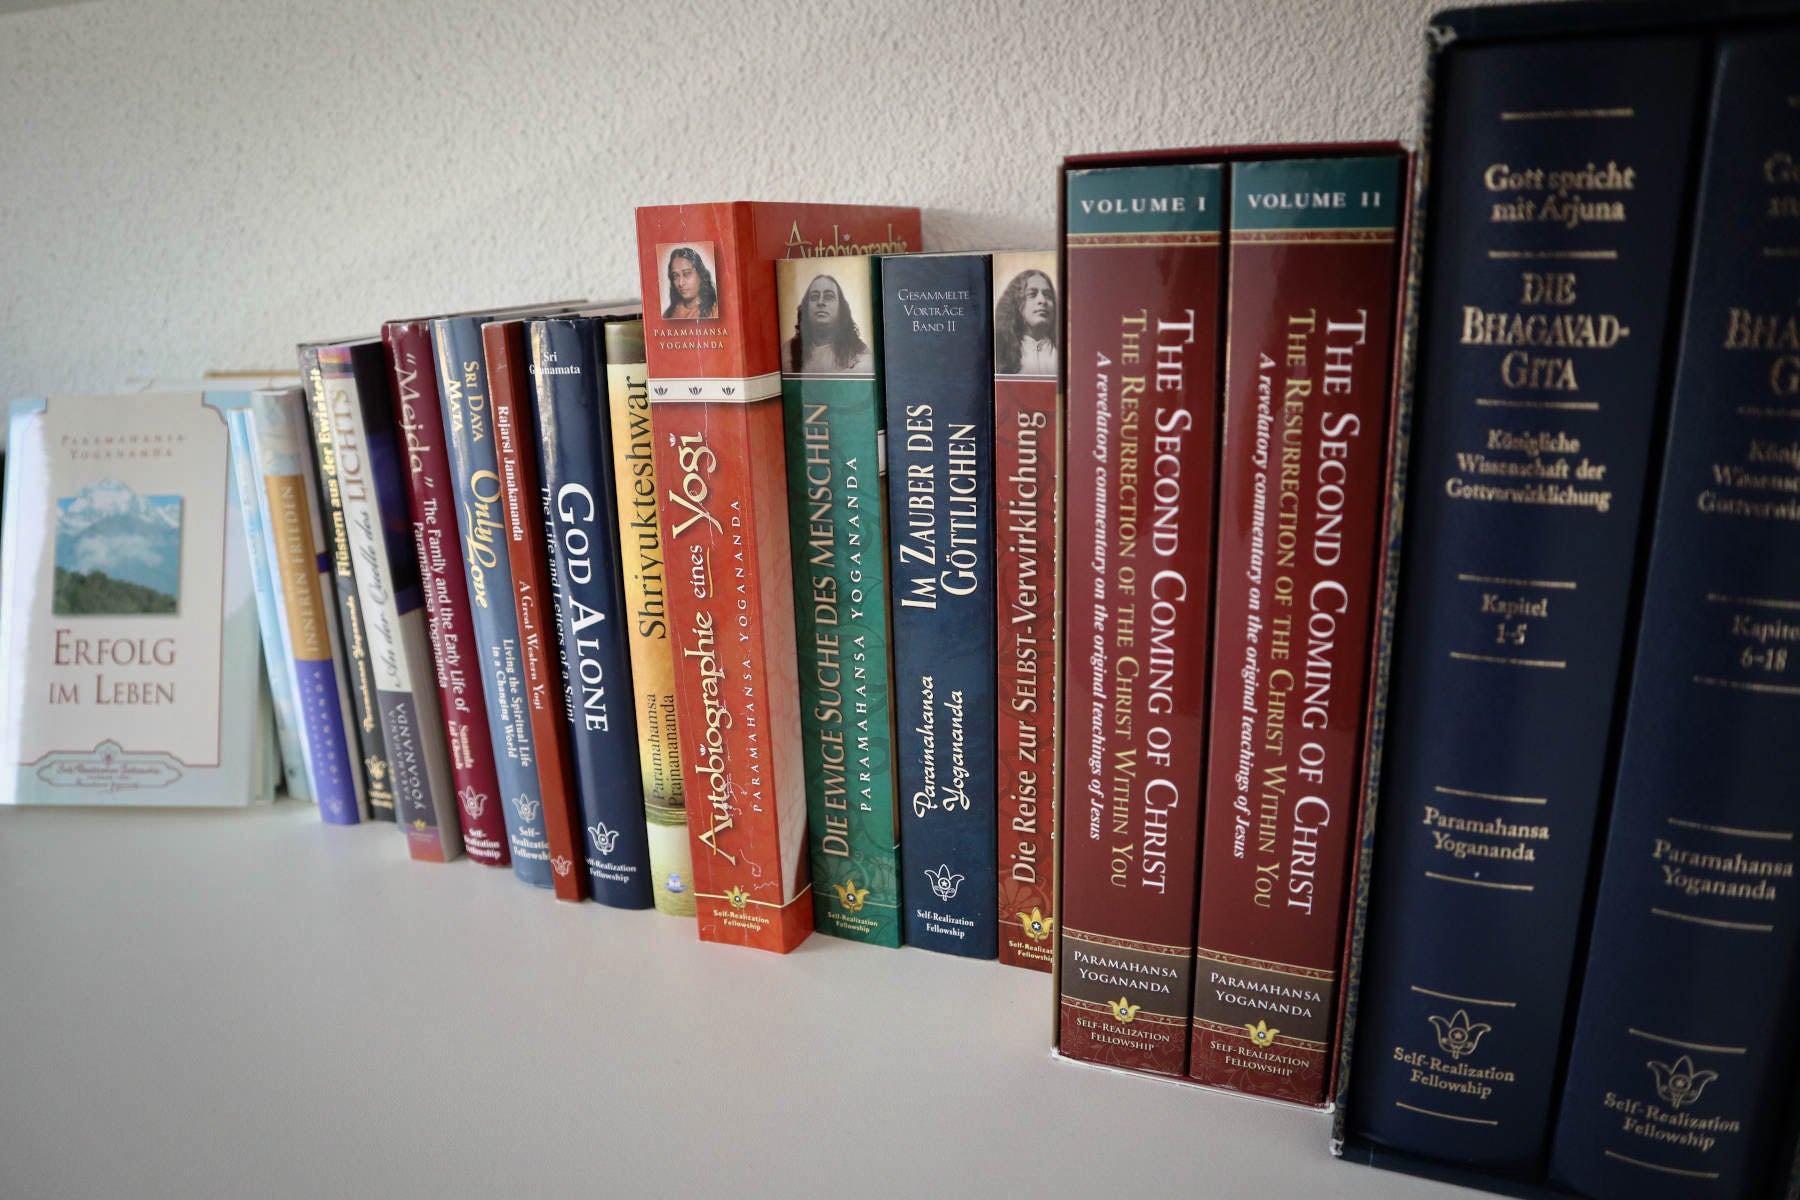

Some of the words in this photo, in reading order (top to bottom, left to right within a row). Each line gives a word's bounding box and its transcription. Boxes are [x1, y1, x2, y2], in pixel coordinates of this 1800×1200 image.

[1247, 192, 1347, 209] VOLUME
[1360, 191, 1381, 207] II
[1484, 163, 1544, 192] Gott
[1549, 161, 1636, 197] spricht
[1081, 197, 1186, 214] VOLUME
[1490, 197, 1535, 222] mit
[1539, 194, 1626, 229] Arjuna
[898, 288, 970, 301] GESAMMELTE
[904, 304, 965, 317] VORTRÄGE
[1521, 272, 1577, 306] DIE
[653, 326, 728, 337] PARAMAHANSA
[659, 340, 725, 350] YOGANANDA
[912, 321, 944, 332] BAND
[1121, 308, 1147, 366] THE
[1286, 308, 1316, 368] THE
[1460, 306, 1630, 348] BHAGAVAD-
[543, 351, 558, 362] Sri
[1096, 351, 1112, 367] A
[1155, 309, 1195, 393] THE
[1259, 351, 1277, 369] A
[1323, 308, 1368, 396] THE
[1501, 350, 1579, 391] GITA
[447, 378, 464, 432] MATA
[468, 394, 485, 442] DAYA
[1092, 373, 1112, 462] revelatory
[1251, 375, 1275, 469] revelatory
[332, 389, 367, 501] LICHTS
[497, 406, 514, 454] Rajarsi
[906, 403, 934, 453] DES
[1487, 428, 1581, 457] Königliche
[323, 447, 337, 475] der
[1118, 375, 1146, 558] RESURRECTION
[1152, 407, 1192, 558] SECOND
[1276, 378, 1312, 568] RESURRECTION
[1456, 452, 1570, 480] Wissenschaft
[1575, 459, 1607, 481] der
[327, 479, 341, 506] aus
[471, 469, 505, 544] Only
[503, 457, 523, 541] Janakananda
[626, 375, 666, 640] Shriyukteshwar
[668, 431, 724, 540] Yogi
[803, 404, 836, 569] MENSCHEN
[1312, 411, 1360, 567] SECOND
[1446, 477, 1612, 512] Gottverwirklichung
[423, 497, 438, 526] The
[900, 463, 936, 566] ZAUBER
[940, 423, 978, 596] GÖTTLICHEN
[1091, 466, 1108, 575] commentary
[1246, 471, 1268, 585] commentary
[332, 510, 351, 577] Flüstern
[427, 529, 447, 575] Family
[464, 502, 498, 609] Love
[557, 482, 595, 584] GOD
[846, 457, 865, 621] YOGANANDA
[412, 522, 435, 613] Paramahansa
[689, 543, 707, 600] eines
[730, 500, 750, 642] YOGANANDA
[1009, 411, 1046, 713] SELBST-Verwirklichung
[1117, 565, 1136, 597] OF
[434, 578, 452, 604] and
[812, 576, 839, 626] DES
[901, 575, 937, 610] IM
[1094, 578, 1107, 602] on
[1248, 588, 1262, 611] on
[1274, 576, 1294, 607] OF
[1481, 593, 1549, 620] Kapitel
[440, 607, 454, 629] the
[521, 595, 535, 631] Great
[553, 590, 565, 646] Letters
[1093, 603, 1109, 626] the
[1116, 603, 1136, 648] THE
[53, 629, 176, 667] ERFOLG
[443, 633, 461, 667] Early
[503, 638, 515, 679] Living
[526, 633, 540, 681] Western
[1148, 569, 1187, 715] COMING
[1270, 614, 1291, 661] THE
[1302, 580, 1349, 730] COMING
[450, 670, 466, 694] Life
[568, 595, 608, 732] ALONE
[814, 632, 843, 725] SUCHE
[1090, 629, 1108, 699] original
[1241, 646, 1260, 714] original
[49, 683, 79, 705] IM
[95, 675, 175, 705] LEBEN
[454, 697, 471, 712] of
[532, 684, 544, 710] Yogi
[1115, 655, 1140, 740] CHRIST
[1264, 667, 1295, 756] CHRIST
[496, 670, 510, 721] Changing
[504, 724, 518, 758] World
[511, 696, 529, 744] Spiritual
[742, 659, 763, 812] PARAMAHANSA
[853, 635, 872, 812] PARAMAHANSA
[396, 702, 427, 810] YOGANANDA
[518, 745, 532, 768] Life
[647, 694, 665, 800] Paramahamsa
[662, 694, 684, 806] Prajnanananda
[684, 611, 736, 866] Autobiographie
[913, 675, 938, 818] Paramahansa
[942, 689, 970, 812] Yogananda
[1018, 719, 1037, 764] zur
[1088, 701, 1107, 777] teachings
[1146, 726, 1172, 768] OF
[1235, 713, 1258, 792] teachings
[820, 728, 848, 811] EWIGE
[1298, 741, 1326, 785] OF
[1010, 769, 1037, 835] Reise
[1112, 748, 1137, 835] WITHIN
[1258, 764, 1288, 855] WITHIN
[822, 814, 850, 859] DIE
[1089, 801, 1104, 841] Jesus
[1142, 778, 1179, 894] CHRIST
[1233, 817, 1251, 859] Jesus
[1423, 806, 1550, 841] Paramahansa
[1010, 840, 1037, 884] Die
[1111, 843, 1134, 888] YOU
[1287, 795, 1330, 916] CHRIST
[1432, 831, 1535, 862] Yogananda
[1651, 838, 1794, 878] Paramahansa
[589, 867, 630, 884] Fellowship
[1254, 862, 1280, 909] YOU
[1662, 865, 1776, 901] Yogananda
[713, 909, 770, 925] Self-Realization
[723, 918, 762, 933] Fellowship
[827, 911, 879, 928] Self-Realization
[836, 920, 871, 934] Fellowship
[916, 909, 974, 927] Self-Realization
[926, 922, 966, 939] Fellowship
[1074, 950, 1179, 979] PARAMAHANSA
[1079, 968, 1171, 995] YOGANANDA
[1211, 971, 1321, 1002] PARAMAHANSA
[1215, 990, 1312, 1018] YOGANANDA
[1076, 1017, 1170, 1042] SELF-REALIZATION
[1091, 1033, 1155, 1051] FELLOWSHIP
[1210, 1040, 1310, 1068] SELF-REALIZATION
[1225, 1055, 1293, 1076] FELLOWSHIP
[1393, 1046, 1515, 1084] Self-Realization
[1410, 1070, 1492, 1099] Fellowship
[1604, 1092, 1740, 1133] Self-Realization
[1622, 1117, 1716, 1152] Fellowship
